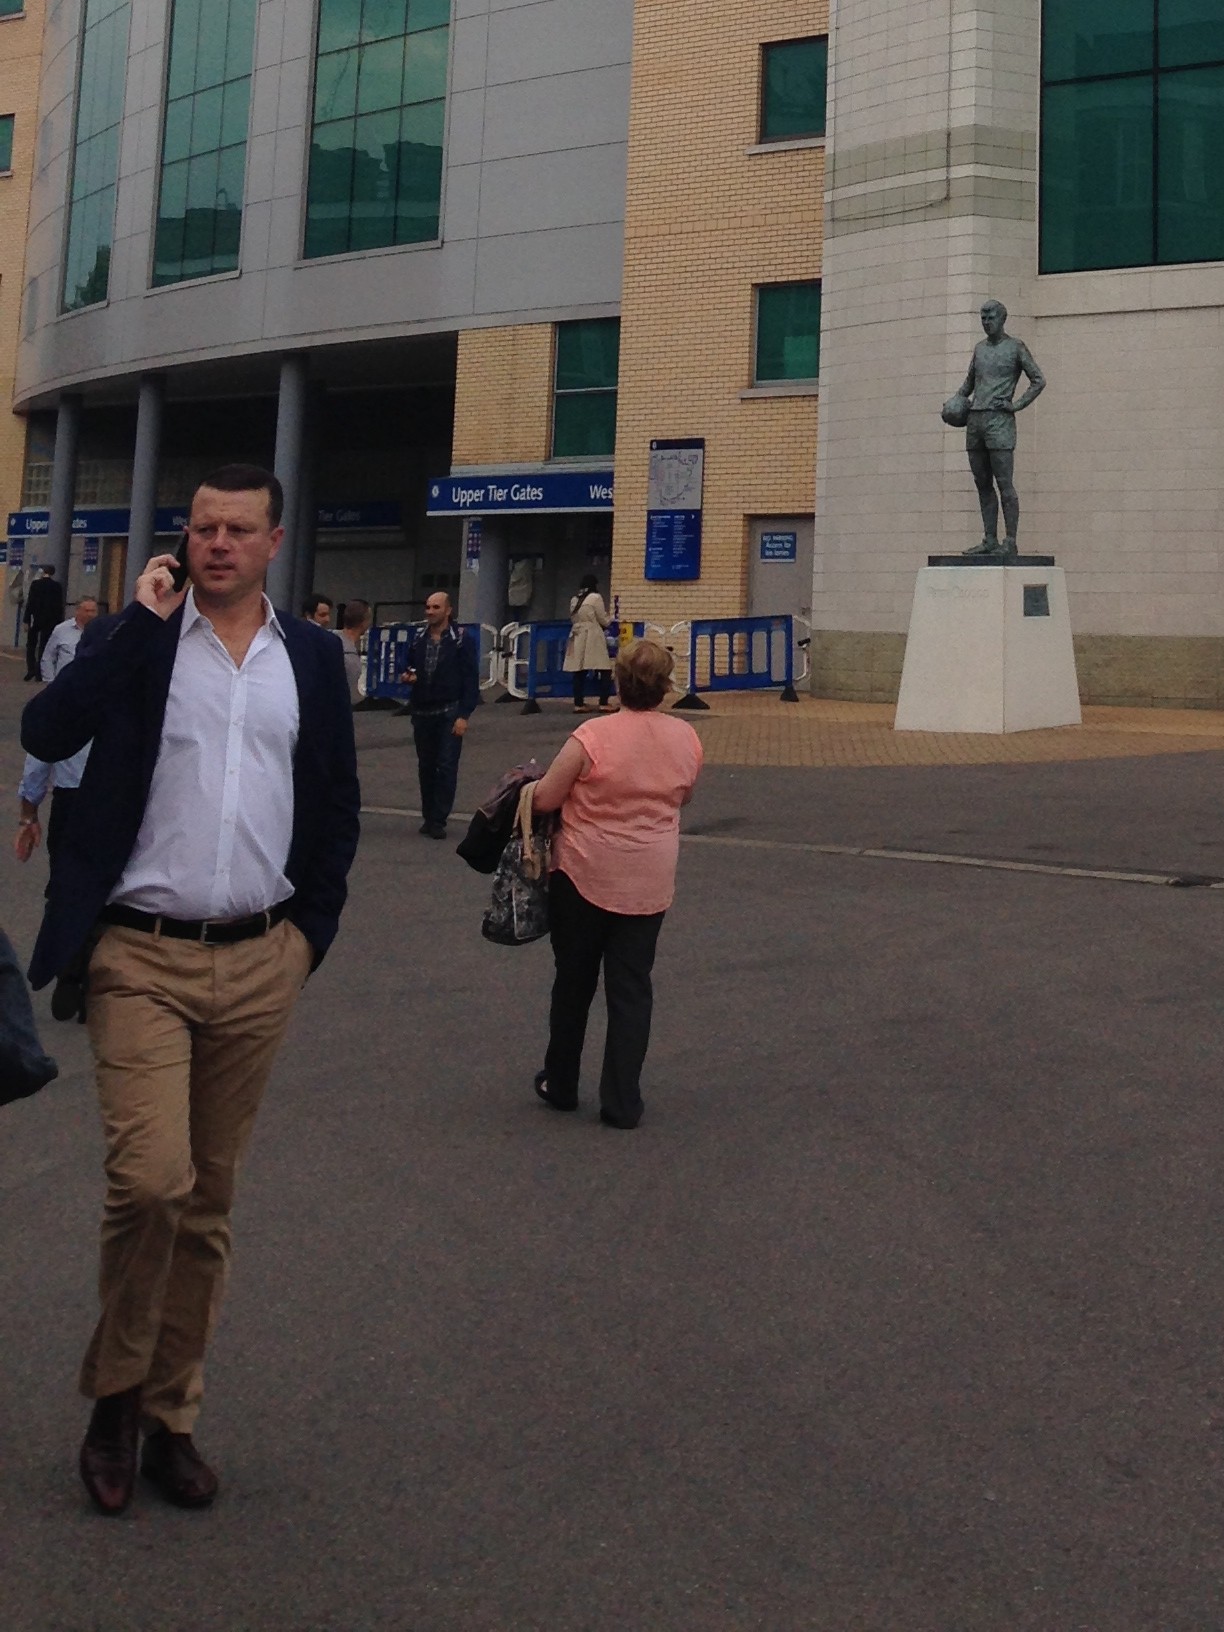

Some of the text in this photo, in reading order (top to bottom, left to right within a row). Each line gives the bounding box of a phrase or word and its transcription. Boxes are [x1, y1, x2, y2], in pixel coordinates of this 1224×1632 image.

[452, 484, 613, 507] Upper Tier Gates Wes
[25, 517, 49, 533] Upper
[71, 518, 88, 529] ates
